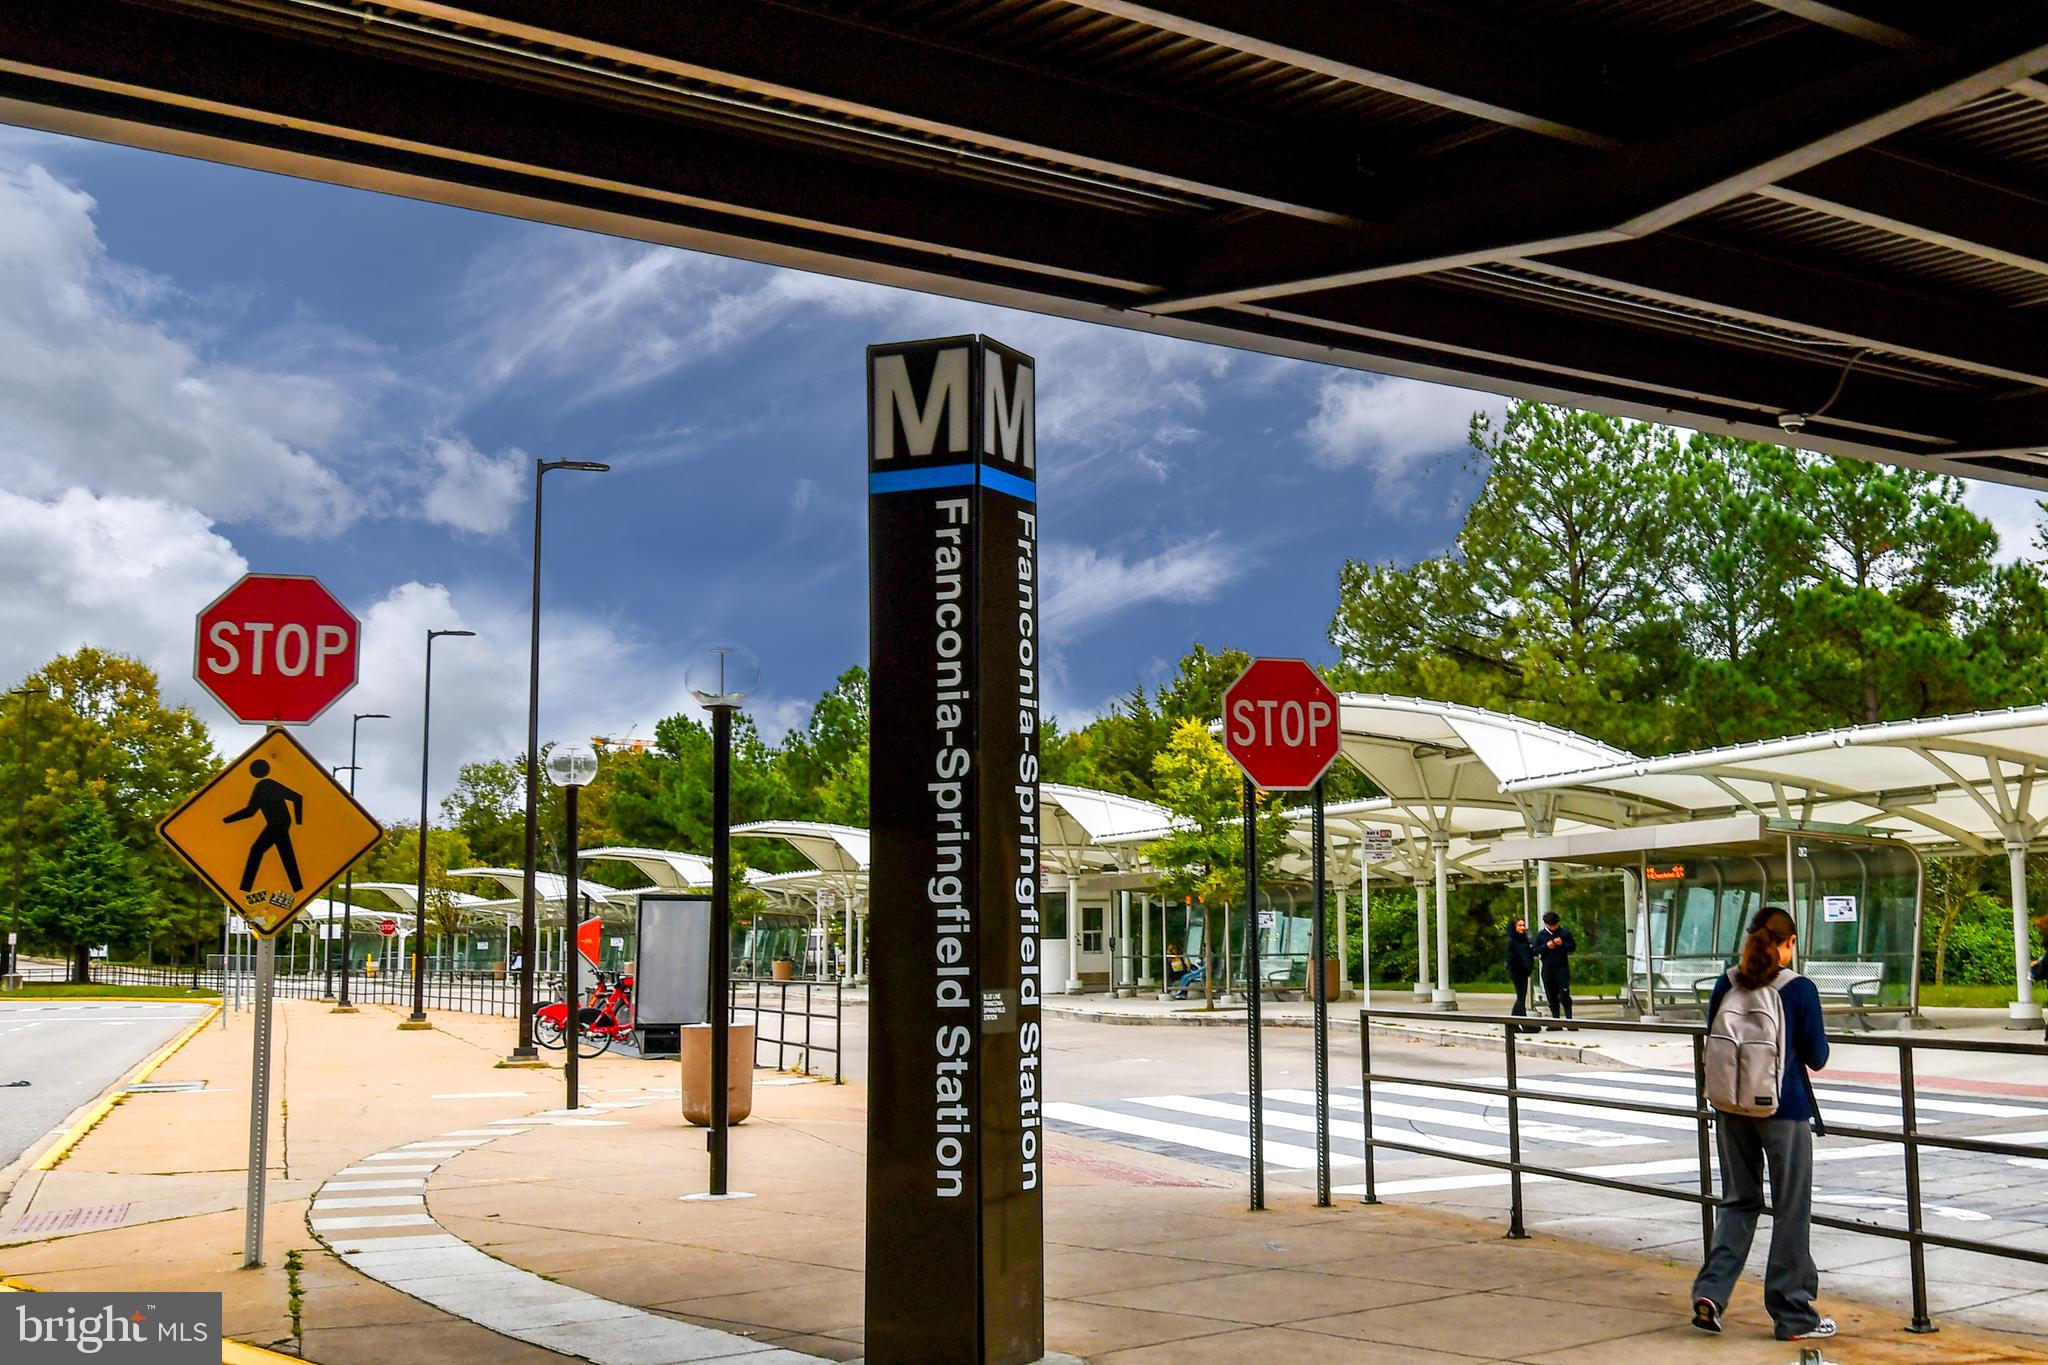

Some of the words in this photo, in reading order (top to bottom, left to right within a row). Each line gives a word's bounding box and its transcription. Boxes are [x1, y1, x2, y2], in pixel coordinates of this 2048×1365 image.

[875, 348, 968, 460] M
[984, 349, 1033, 470] M
[207, 621, 349, 677] STOP
[928, 498, 970, 1007] Franconia-Springfield
[1014, 510, 1039, 1006] Franconia-Springfield
[1232, 699, 1331, 747] STOP
[380, 923, 395, 932] STOP
[935, 1025, 971, 1197] Station
[1020, 1022, 1040, 1191] Station
